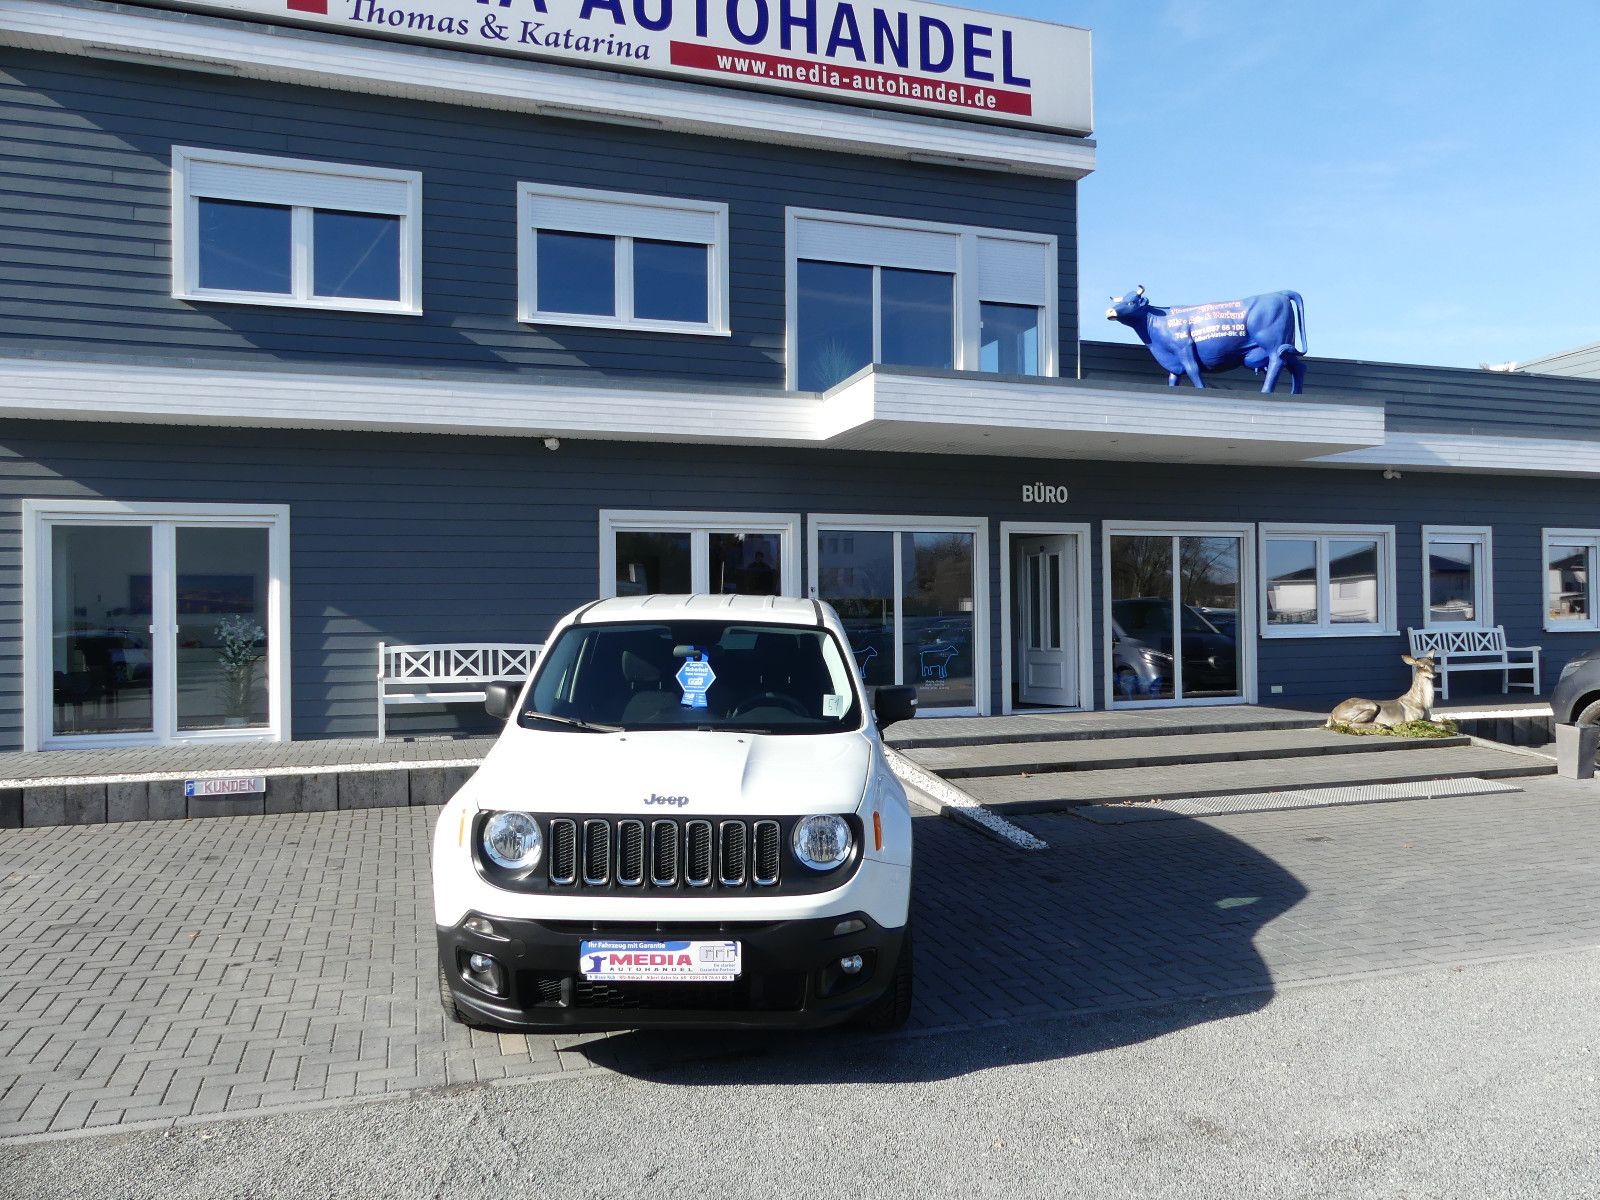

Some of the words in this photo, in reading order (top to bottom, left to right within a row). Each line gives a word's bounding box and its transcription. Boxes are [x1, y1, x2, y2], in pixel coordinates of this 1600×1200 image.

[346, 0, 469, 36] Thomas
[480, 13, 509, 41] &
[517, 20, 650, 60] Katarina
[717, 52, 997, 109] www.media-autohandel.de
[1022, 482, 1068, 503] BÜRO
[186, 783, 194, 793] P
[204, 779, 256, 794] KUNDEN
[643, 793, 690, 808] Jeep
[609, 953, 693, 966] MEDIA
